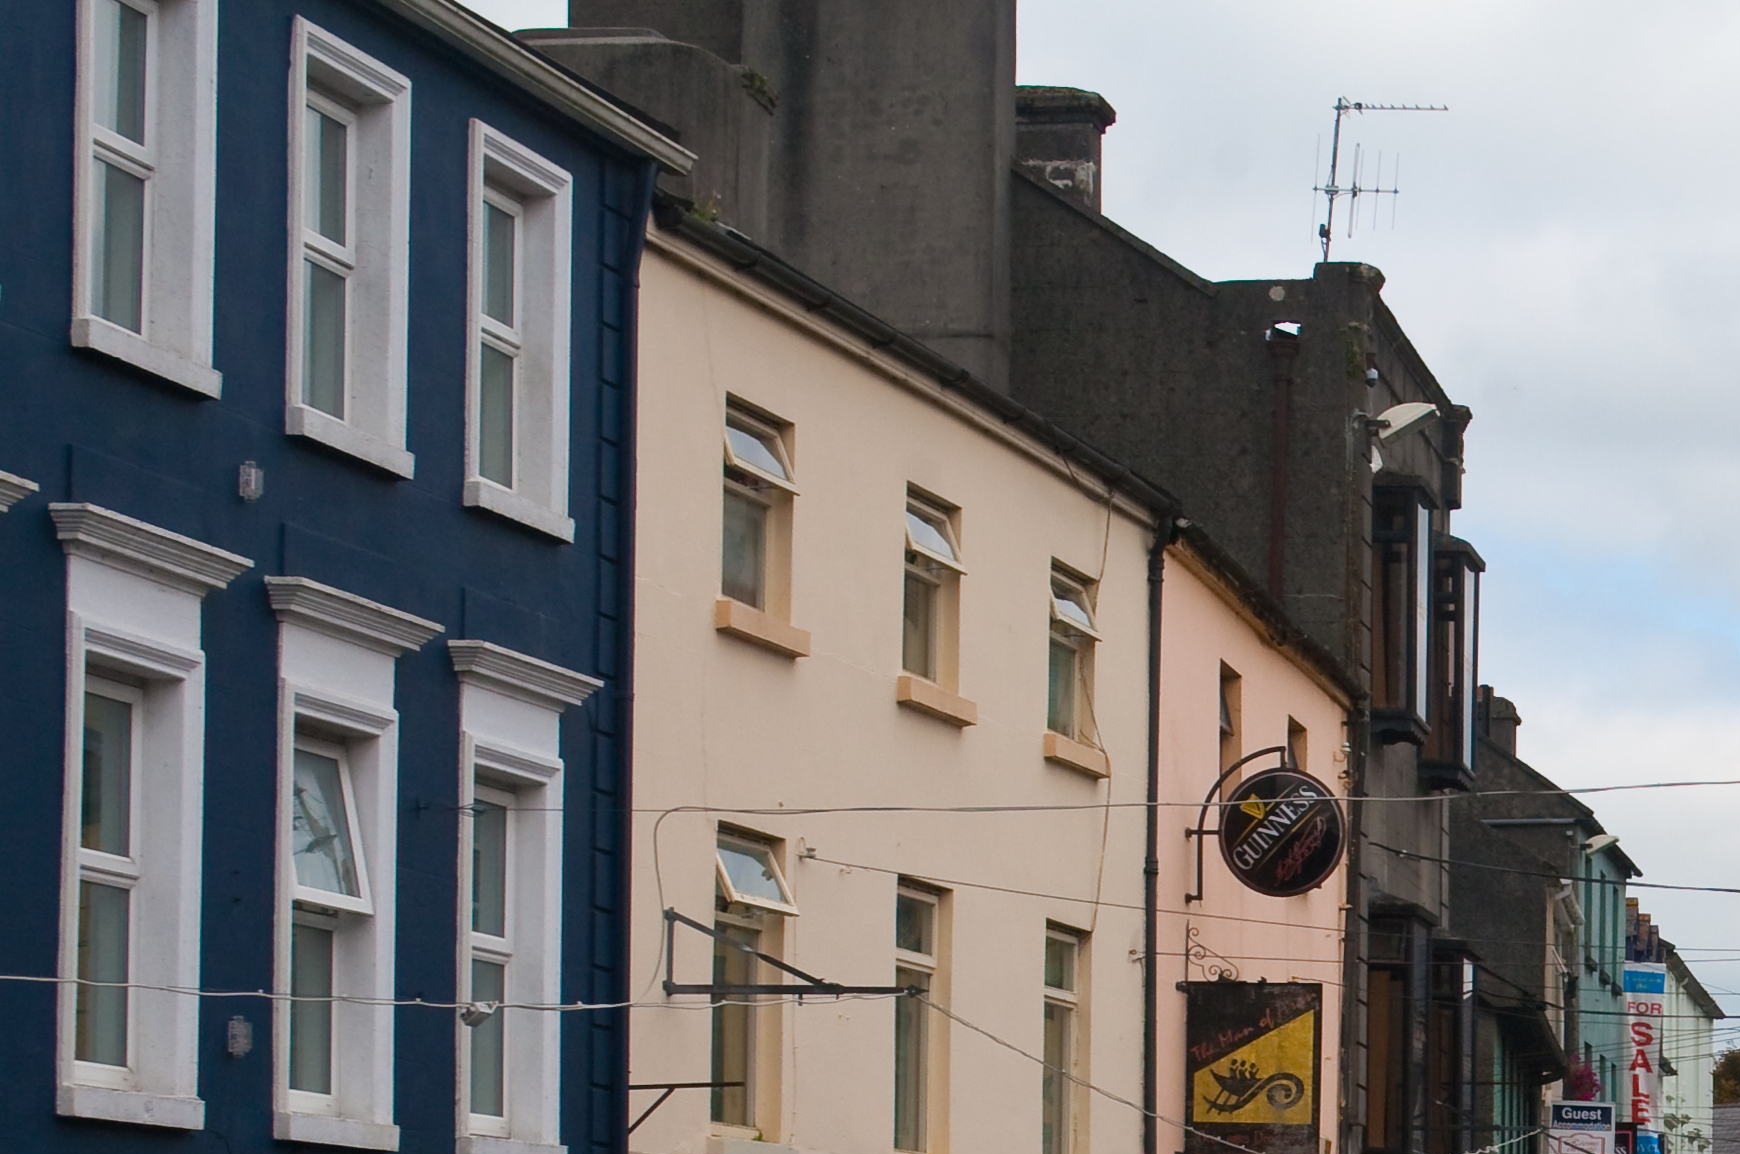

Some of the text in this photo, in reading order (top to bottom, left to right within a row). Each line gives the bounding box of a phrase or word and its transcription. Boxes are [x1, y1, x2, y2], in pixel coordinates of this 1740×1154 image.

[1233, 786, 1318, 870] GUINNESS
[1627, 1001, 1662, 1015] FOR
[1629, 1021, 1654, 1124] SALE
[1561, 1108, 1602, 1121] Guest
[1552, 1120, 1611, 1131] Accommodation
